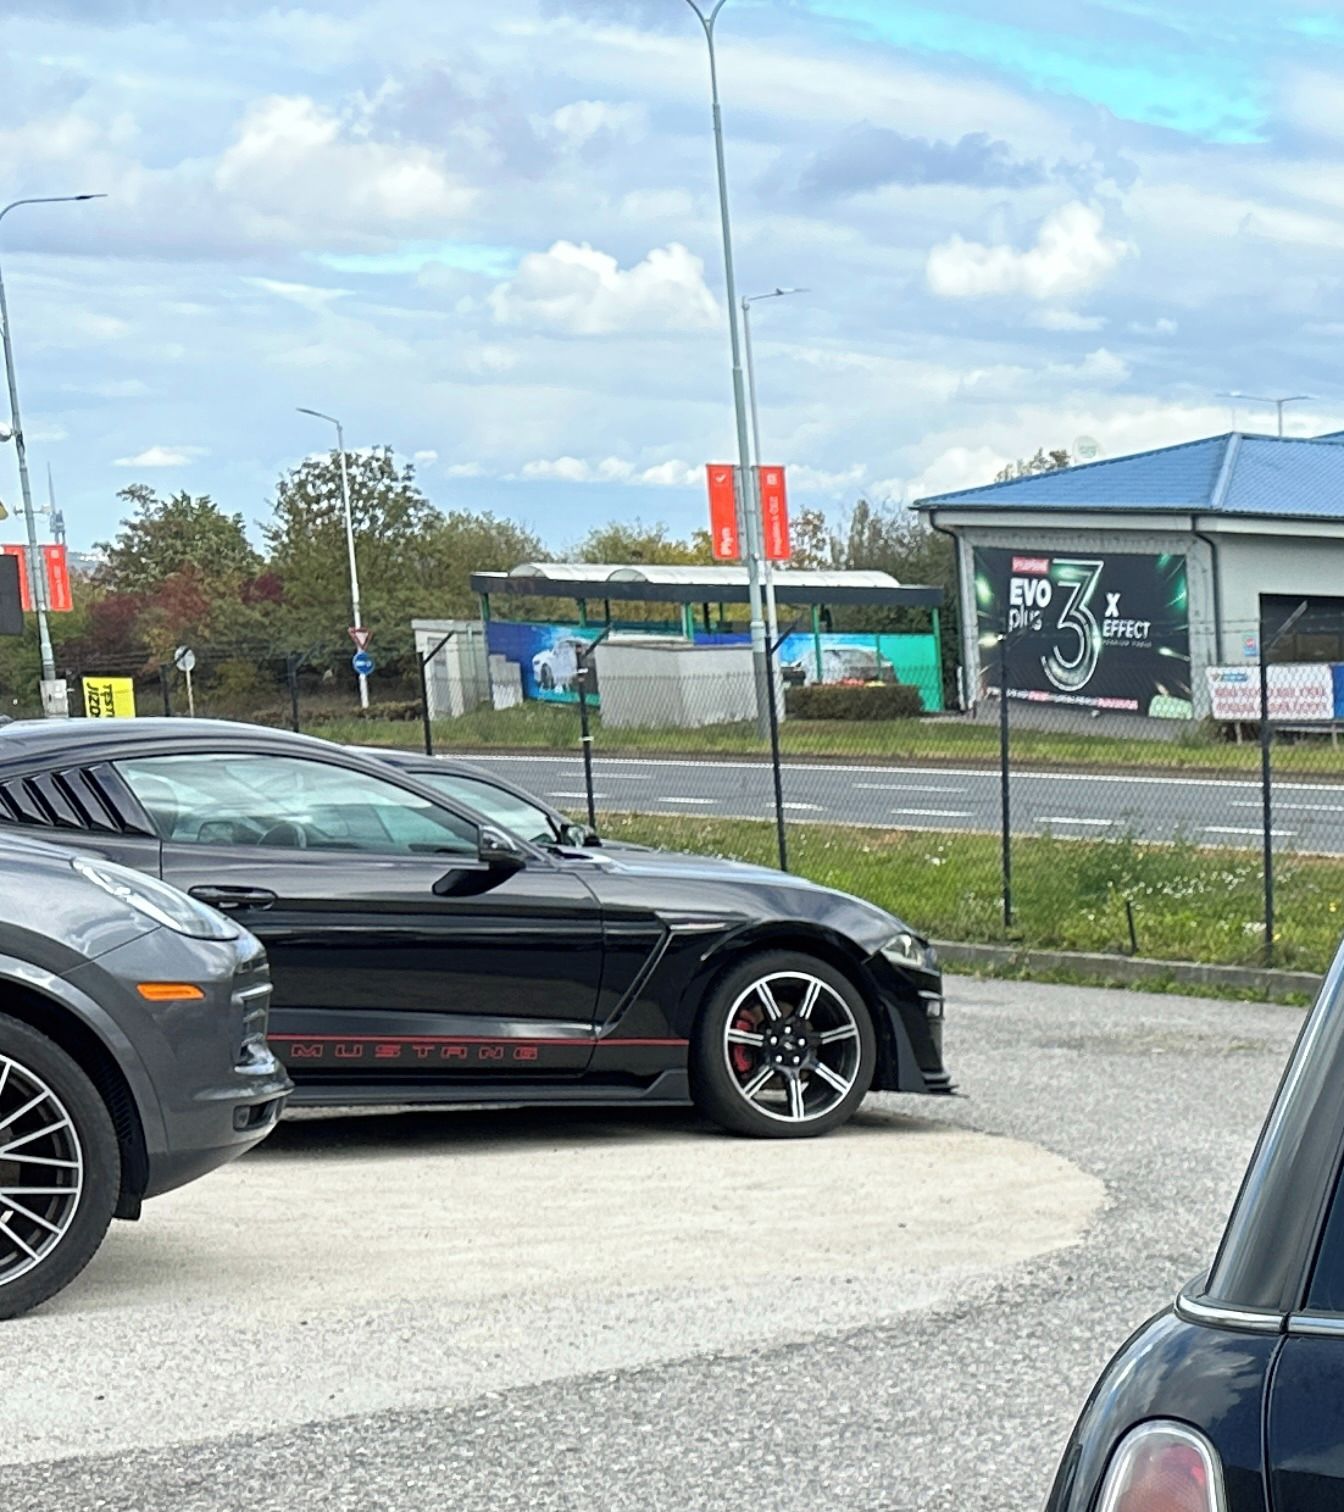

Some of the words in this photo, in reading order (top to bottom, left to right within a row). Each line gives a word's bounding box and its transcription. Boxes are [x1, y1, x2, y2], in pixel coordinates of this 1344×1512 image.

[1010, 577, 1052, 607] EVO
[1041, 558, 1104, 691] 3
[1103, 619, 1151, 639] EFFECT
[291, 1044, 538, 1060] MUSTANG
